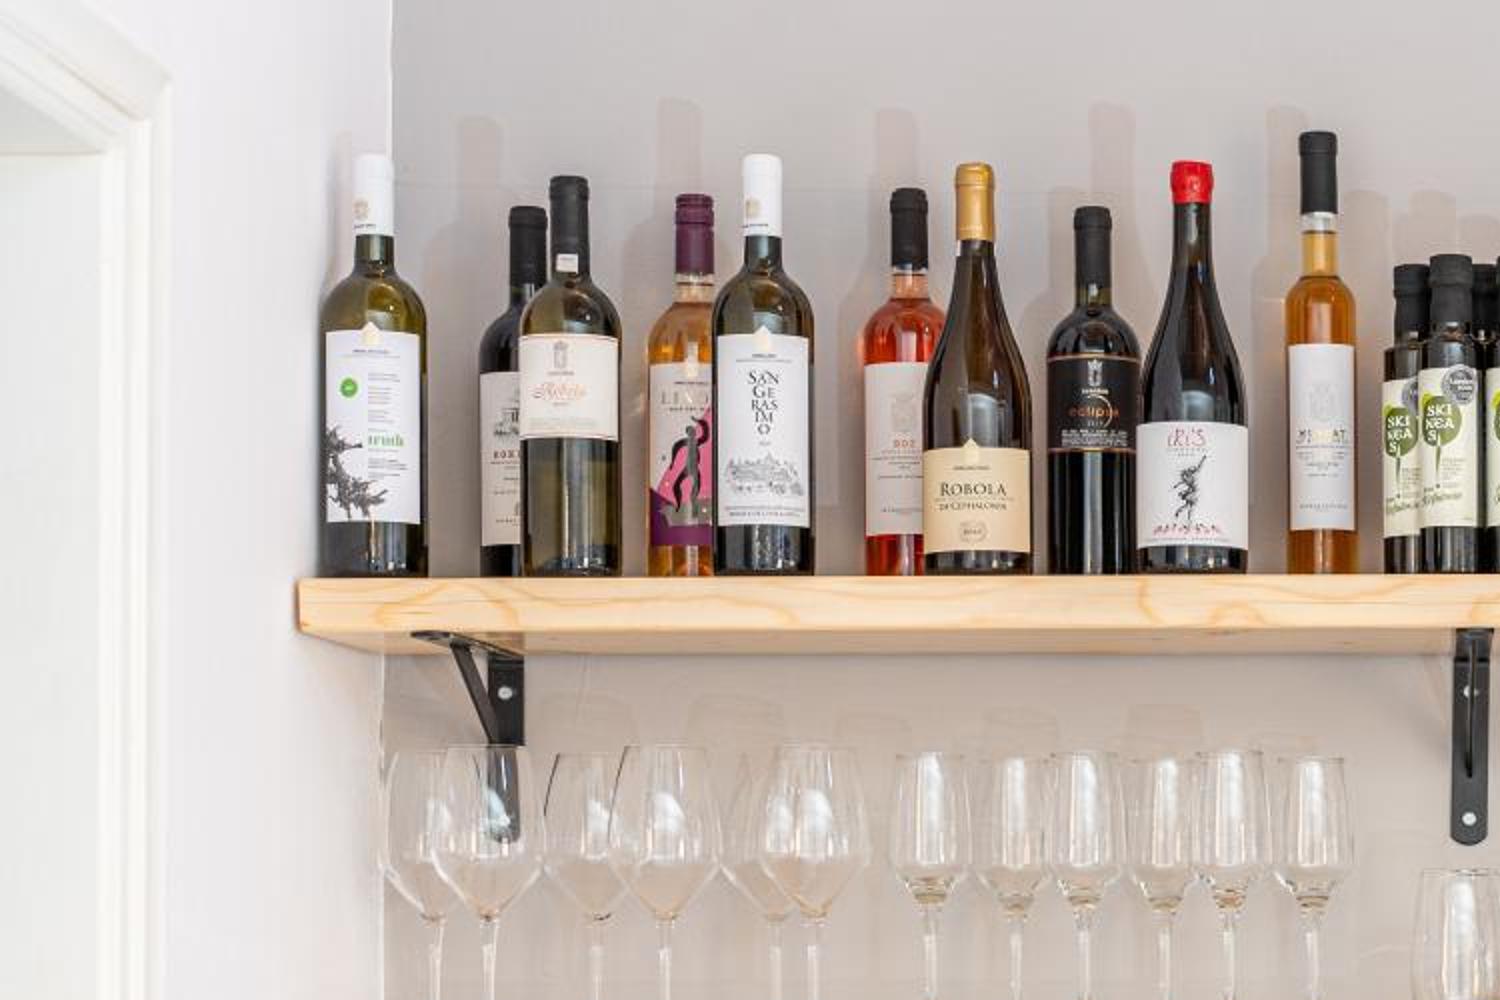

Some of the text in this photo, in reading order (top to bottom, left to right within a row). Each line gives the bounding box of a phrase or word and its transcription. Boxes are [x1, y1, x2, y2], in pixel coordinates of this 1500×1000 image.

[747, 370, 780, 384] SAN
[1427, 403, 1453, 417] SKI
[940, 481, 1007, 497] ROBOLA
